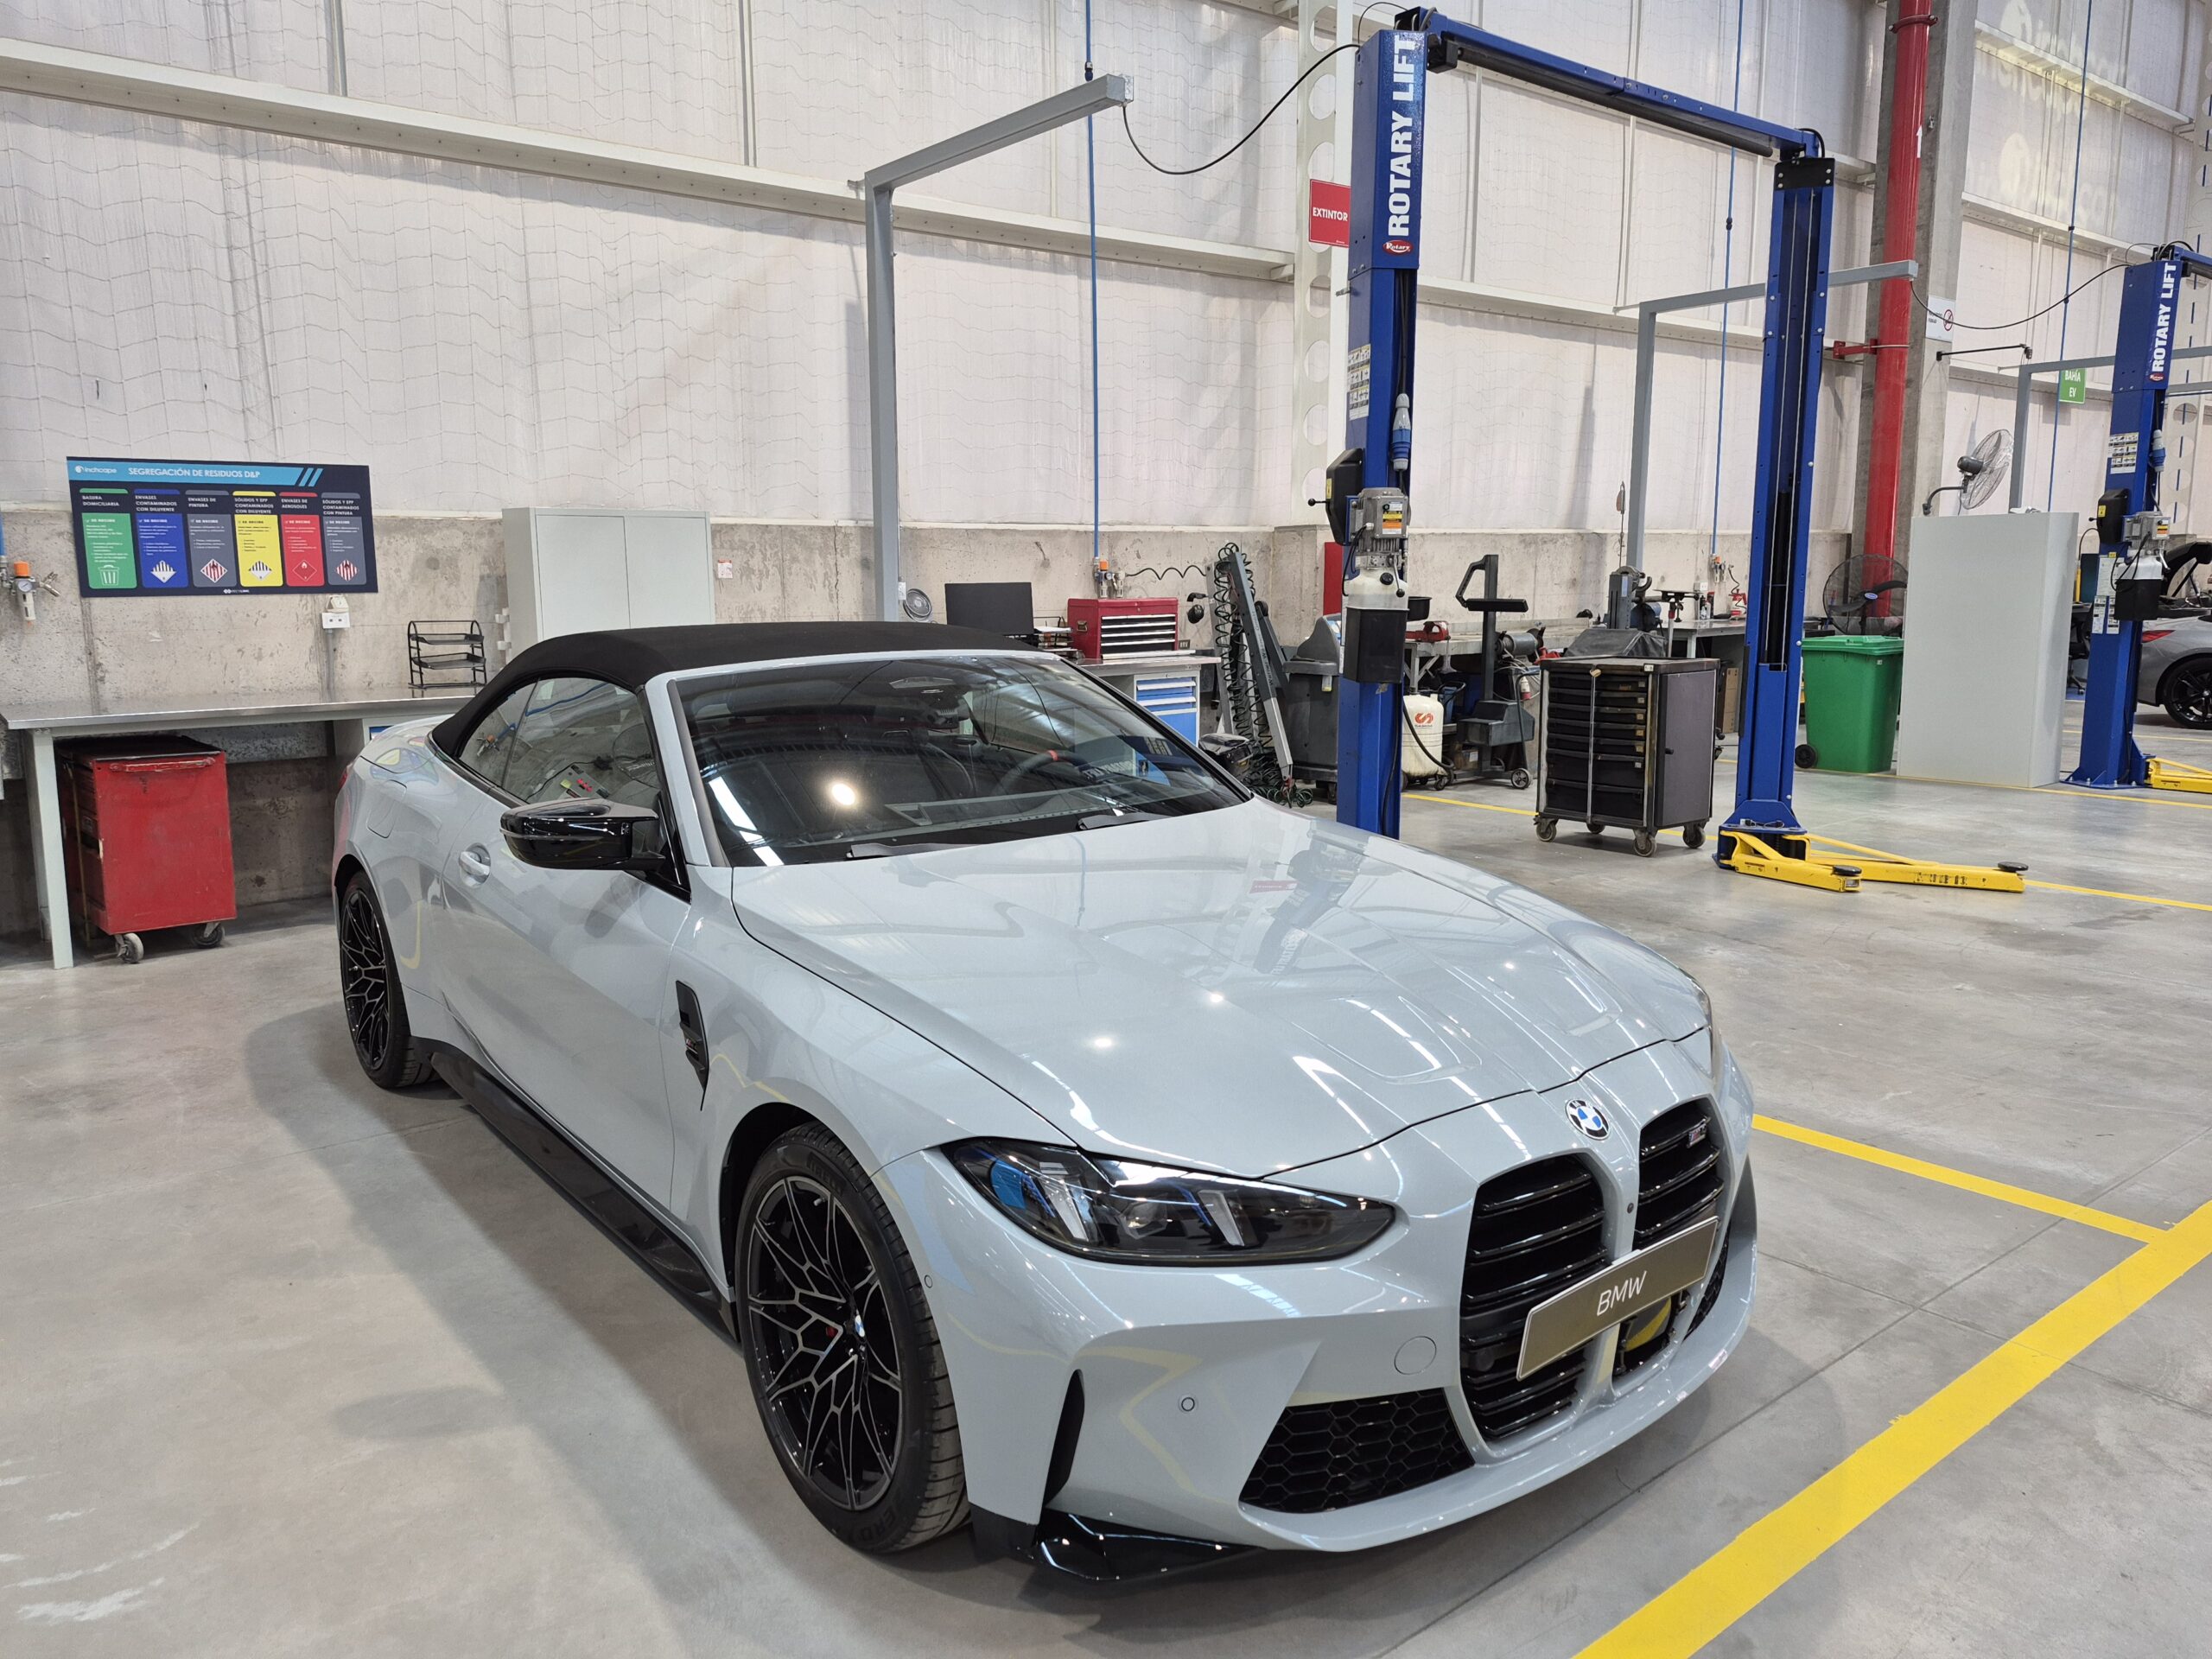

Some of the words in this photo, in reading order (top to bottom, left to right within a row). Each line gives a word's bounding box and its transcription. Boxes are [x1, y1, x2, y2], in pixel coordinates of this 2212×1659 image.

[1392, 35, 1415, 101] LIFT
[1389, 111, 1413, 237] ROTARY
[1313, 207, 1348, 221] EXTINTOR
[1386, 242, 1410, 252] Rotary
[2161, 262, 2177, 299] LIFT
[2152, 303, 2171, 372] ROTARY
[2065, 369, 2082, 382] BAHÍA
[2069, 387, 2076, 397] EV
[129, 467, 190, 476] SEGREGACIÓN
[1597, 1269, 1647, 1316] BMW
